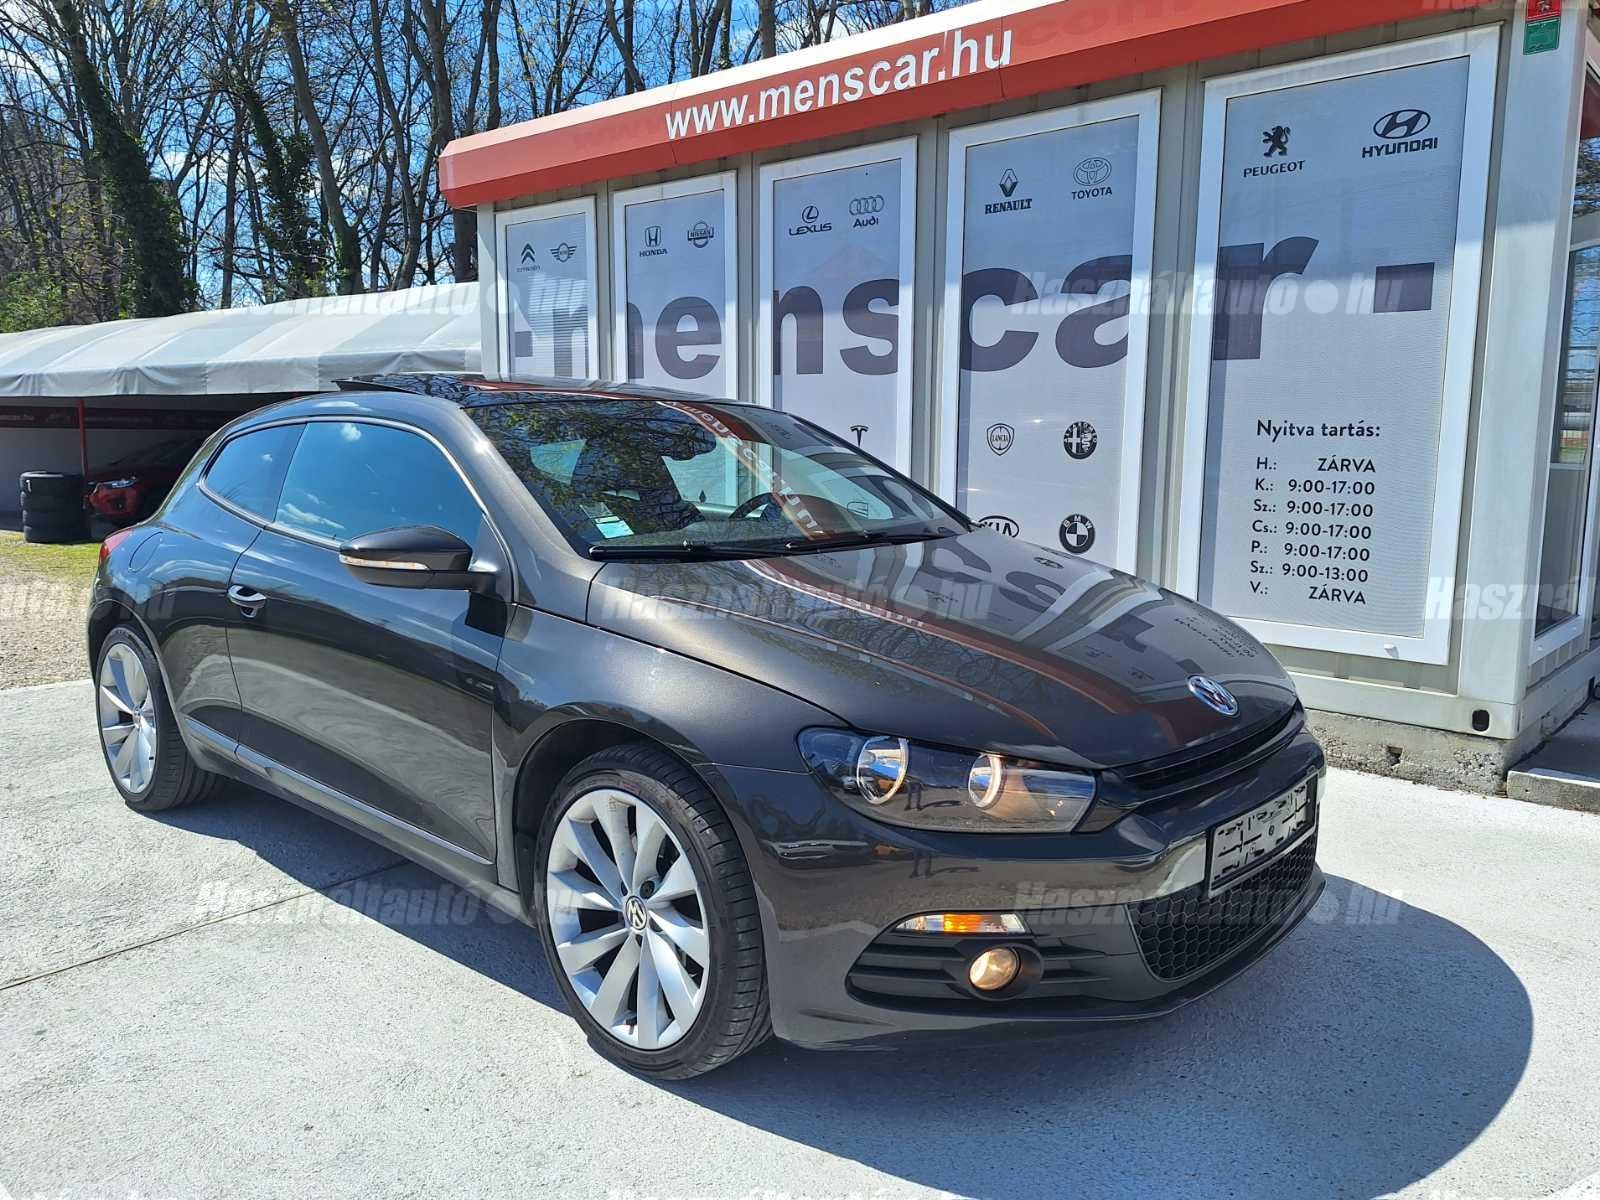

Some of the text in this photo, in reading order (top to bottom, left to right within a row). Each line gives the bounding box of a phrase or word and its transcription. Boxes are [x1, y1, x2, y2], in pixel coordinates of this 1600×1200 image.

[665, 28, 1012, 140] www.menscar.hu
[1361, 137, 1438, 158] HYUNDAI
[1243, 160, 1305, 178] PEUGEOT
[1071, 186, 1113, 200] TOYOTA
[984, 198, 1032, 215] RENAULT
[788, 222, 832, 236] LEXUS
[853, 215, 879, 228] Audi
[639, 248, 668, 257] HONDA
[1256, 419, 1381, 443] Nyitva tartás:
[1256, 454, 1376, 473] H.: ZÁRVA
[1255, 478, 1376, 495] K.: 9:00-17:00
[1253, 499, 1374, 517] Sz.: 9:00-17:00
[1252, 520, 1372, 540] Cs.: 9:00-17:00
[1251, 540, 1370, 561] P.: 9:00-17:00
[1250, 560, 1369, 582] Sz.: 9:00-13:00
[1249, 580, 1367, 605] V.: ZÁRVA
